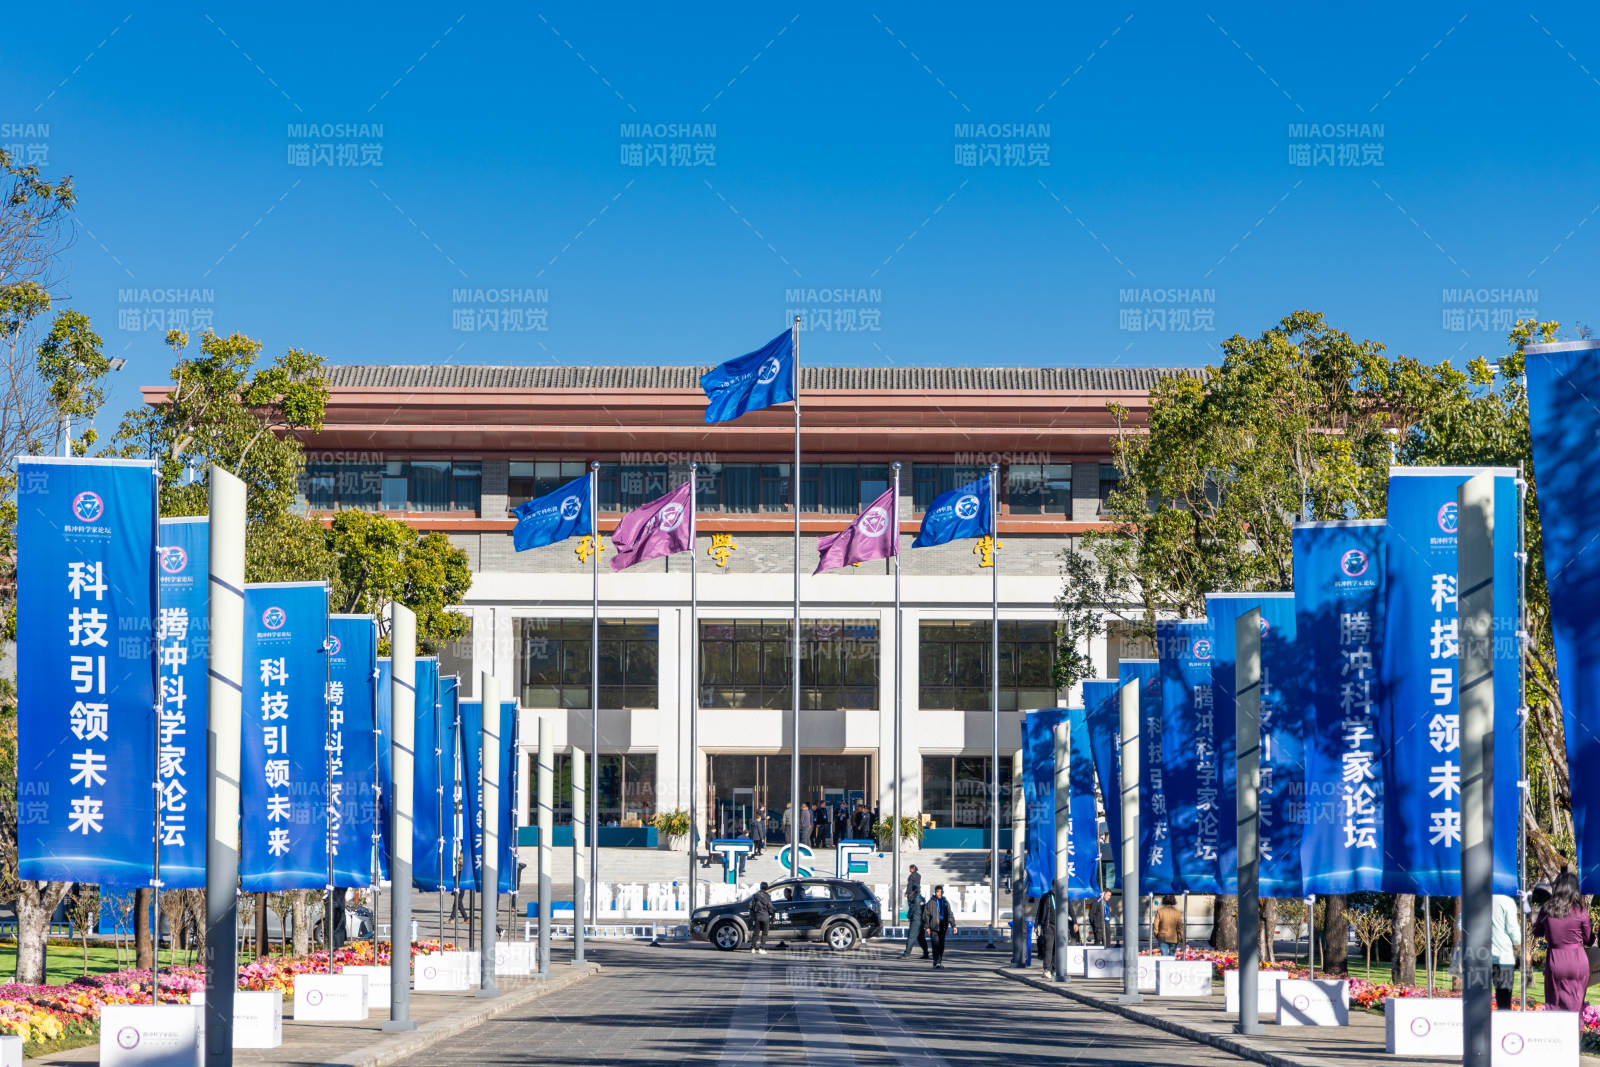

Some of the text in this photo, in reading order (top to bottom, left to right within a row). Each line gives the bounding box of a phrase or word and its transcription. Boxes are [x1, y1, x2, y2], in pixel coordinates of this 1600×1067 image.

[68, 561, 109, 836] 科技引领未来
[155, 607, 189, 847] 腾冲科学家论坛
[260, 656, 290, 857] 科技引领未来
[1193, 685, 1219, 861] 腾冲科学家论坛
[1339, 612, 1378, 849] 腾冲科学家论坛
